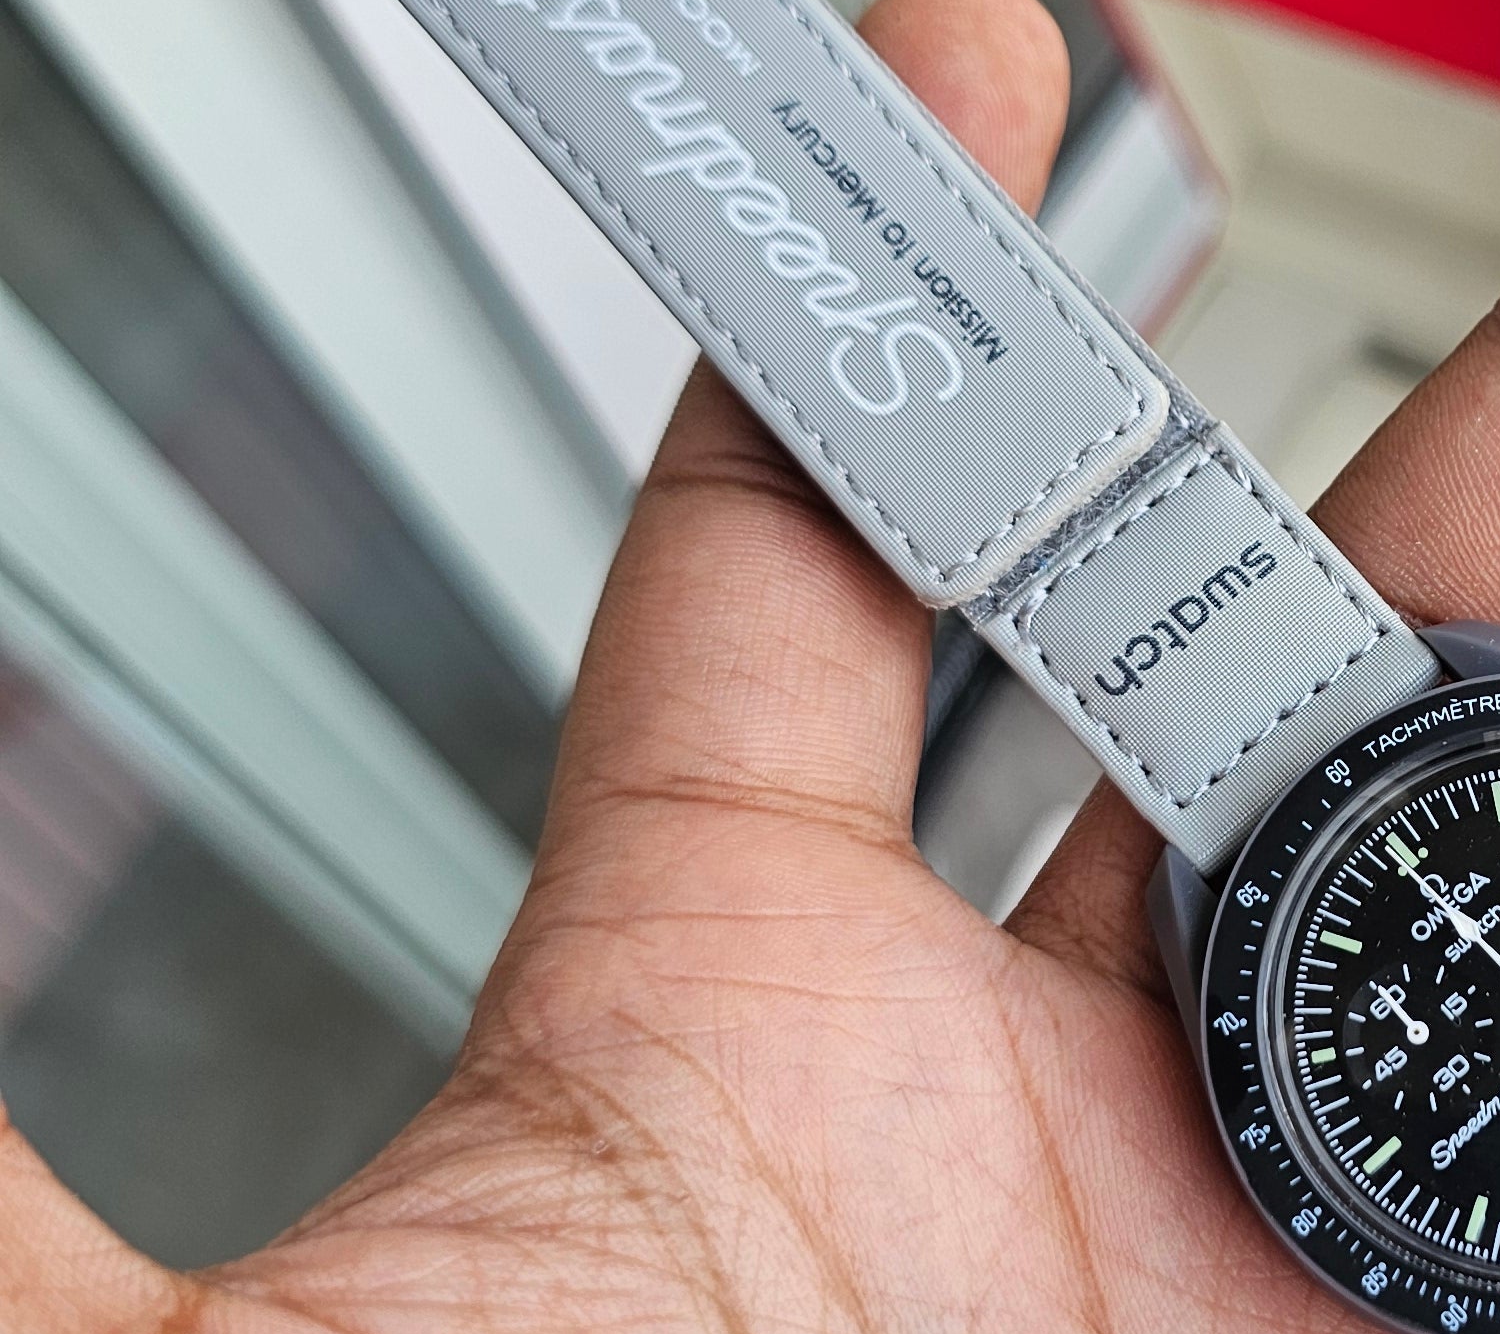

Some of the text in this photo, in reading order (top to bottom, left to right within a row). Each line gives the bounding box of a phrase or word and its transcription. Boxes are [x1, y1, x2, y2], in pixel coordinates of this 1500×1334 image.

[771, 97, 1009, 366] Mission to Mercury
[1094, 540, 1279, 696] swatch
[1325, 758, 1351, 784] 60
[1236, 880, 1262, 908] 65
[1440, 991, 1468, 1020] 15
[1213, 1011, 1241, 1036] 70
[1375, 1046, 1408, 1082] 45
[1433, 1054, 1470, 1092] 30
[1239, 1123, 1267, 1151] 75
[1291, 1208, 1318, 1238] 80
[1361, 1266, 1388, 1297] 85
[1440, 1302, 1468, 1333] 90
